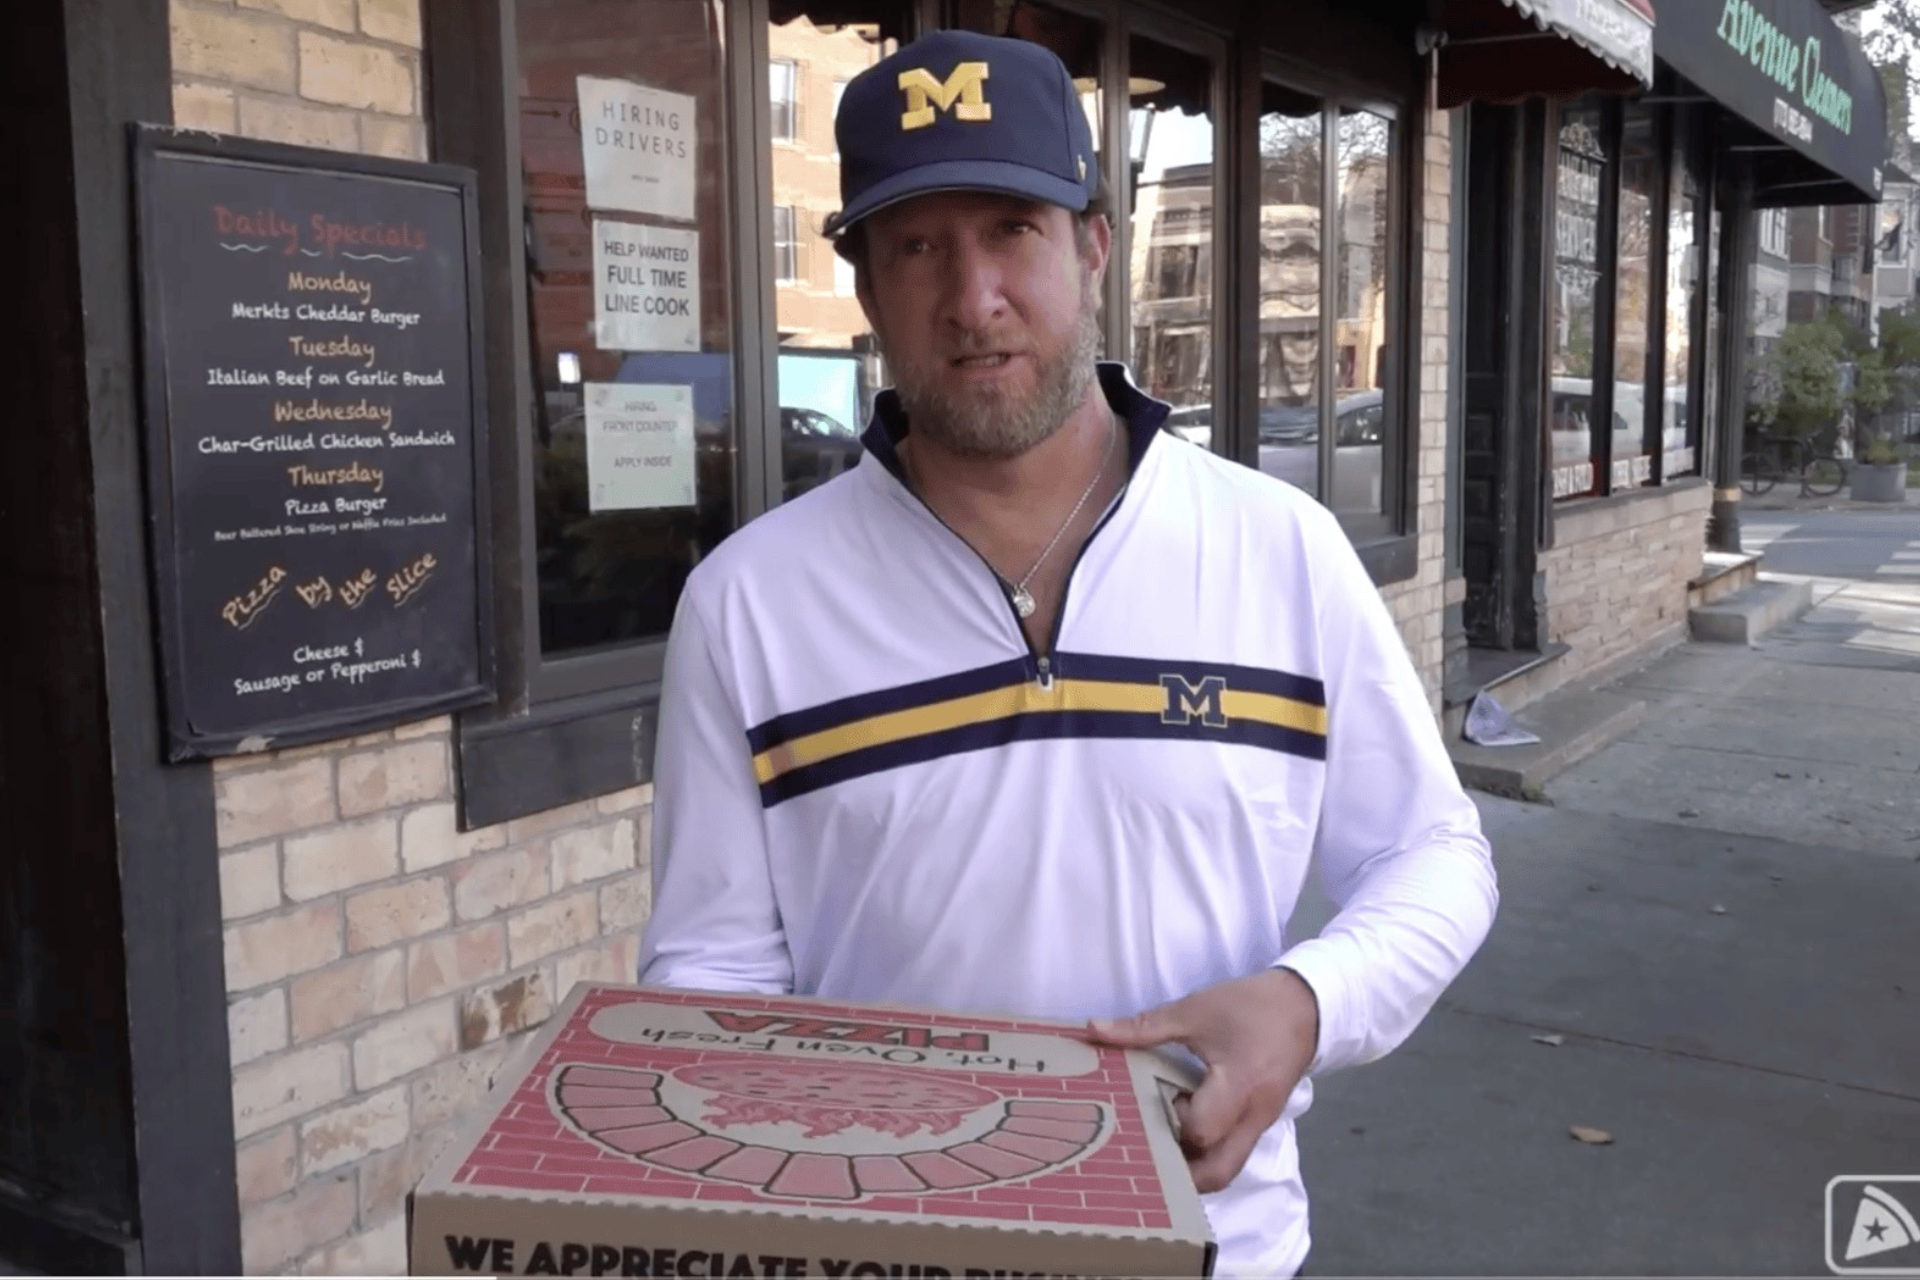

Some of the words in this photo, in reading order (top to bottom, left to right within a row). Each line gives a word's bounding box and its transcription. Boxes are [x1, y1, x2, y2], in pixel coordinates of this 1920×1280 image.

[1717, 0, 1799, 92] Avenue
[898, 62, 991, 130] M
[602, 101, 679, 131] HIRING
[595, 127, 685, 158] DRIVERS
[213, 205, 298, 255] Daily
[310, 213, 428, 257] Specials
[604, 241, 636, 256] HELP
[639, 244, 689, 262] WANTED
[287, 272, 371, 305] Monday
[607, 265, 645, 285] FULL
[650, 269, 687, 288] TIME
[296, 305, 365, 322] Cheddar
[371, 309, 420, 329] Burger
[605, 294, 640, 313] LINE
[643, 296, 689, 316] COOK
[288, 335, 375, 368] Tuesday
[207, 369, 270, 385] Italian
[276, 366, 312, 389] Beef
[319, 373, 340, 385] on
[346, 370, 397, 385] Garlic
[403, 370, 445, 385] Bread
[274, 399, 393, 430] Wednesday
[198, 433, 315, 453] Char-Grilled
[320, 433, 384, 450] Chicken
[388, 430, 456, 448] Sandwich
[614, 457, 641, 468] APPLY
[643, 455, 672, 467] INSIDE
[287, 462, 385, 493] Thursday
[285, 499, 330, 516] Pizza
[335, 497, 387, 516] Burger
[339, 520, 350, 531] or
[407, 512, 447, 526] Included
[221, 566, 287, 625] Pizza
[296, 575, 333, 606] by
[339, 566, 377, 605] the
[293, 645, 349, 664] Cheese
[354, 637, 364, 657] $
[234, 674, 300, 695] Sausage
[306, 668, 325, 684] or
[330, 653, 407, 684] Pepperoni
[411, 650, 422, 668] $
[1159, 673, 1228, 729] M
[641, 1027, 776, 1052] Fresh
[704, 1010, 990, 1053] PIZZA
[796, 1041, 927, 1064] Oven
[444, 1235, 514, 1273] WE
[524, 1242, 807, 1280] APPRECIATE
